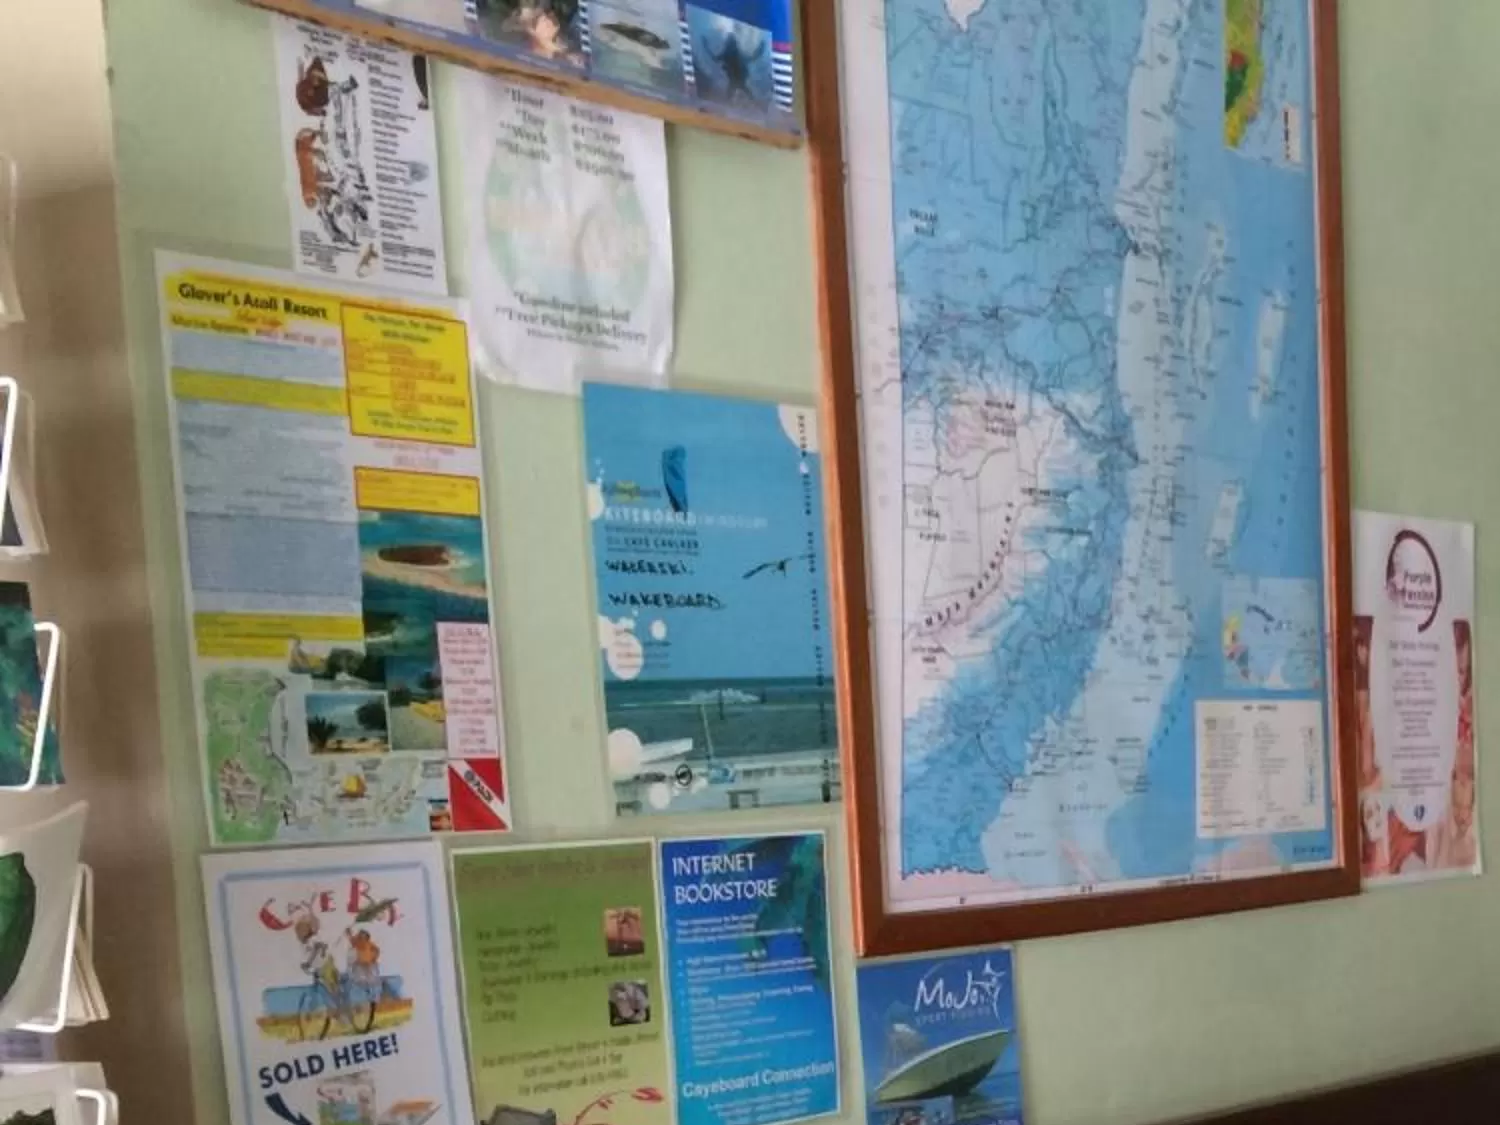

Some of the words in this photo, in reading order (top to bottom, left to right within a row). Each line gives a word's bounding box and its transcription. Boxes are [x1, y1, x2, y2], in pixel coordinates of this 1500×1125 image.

[178, 282, 239, 306] Glover's
[243, 292, 278, 312] Atoll
[283, 297, 328, 319] Resort
[672, 853, 756, 875] INTERNET
[674, 878, 779, 905] BOOKSTORE
[258, 1054, 325, 1090] SOLD
[332, 1031, 399, 1070] HERE!
[762, 1060, 835, 1085] Connection
